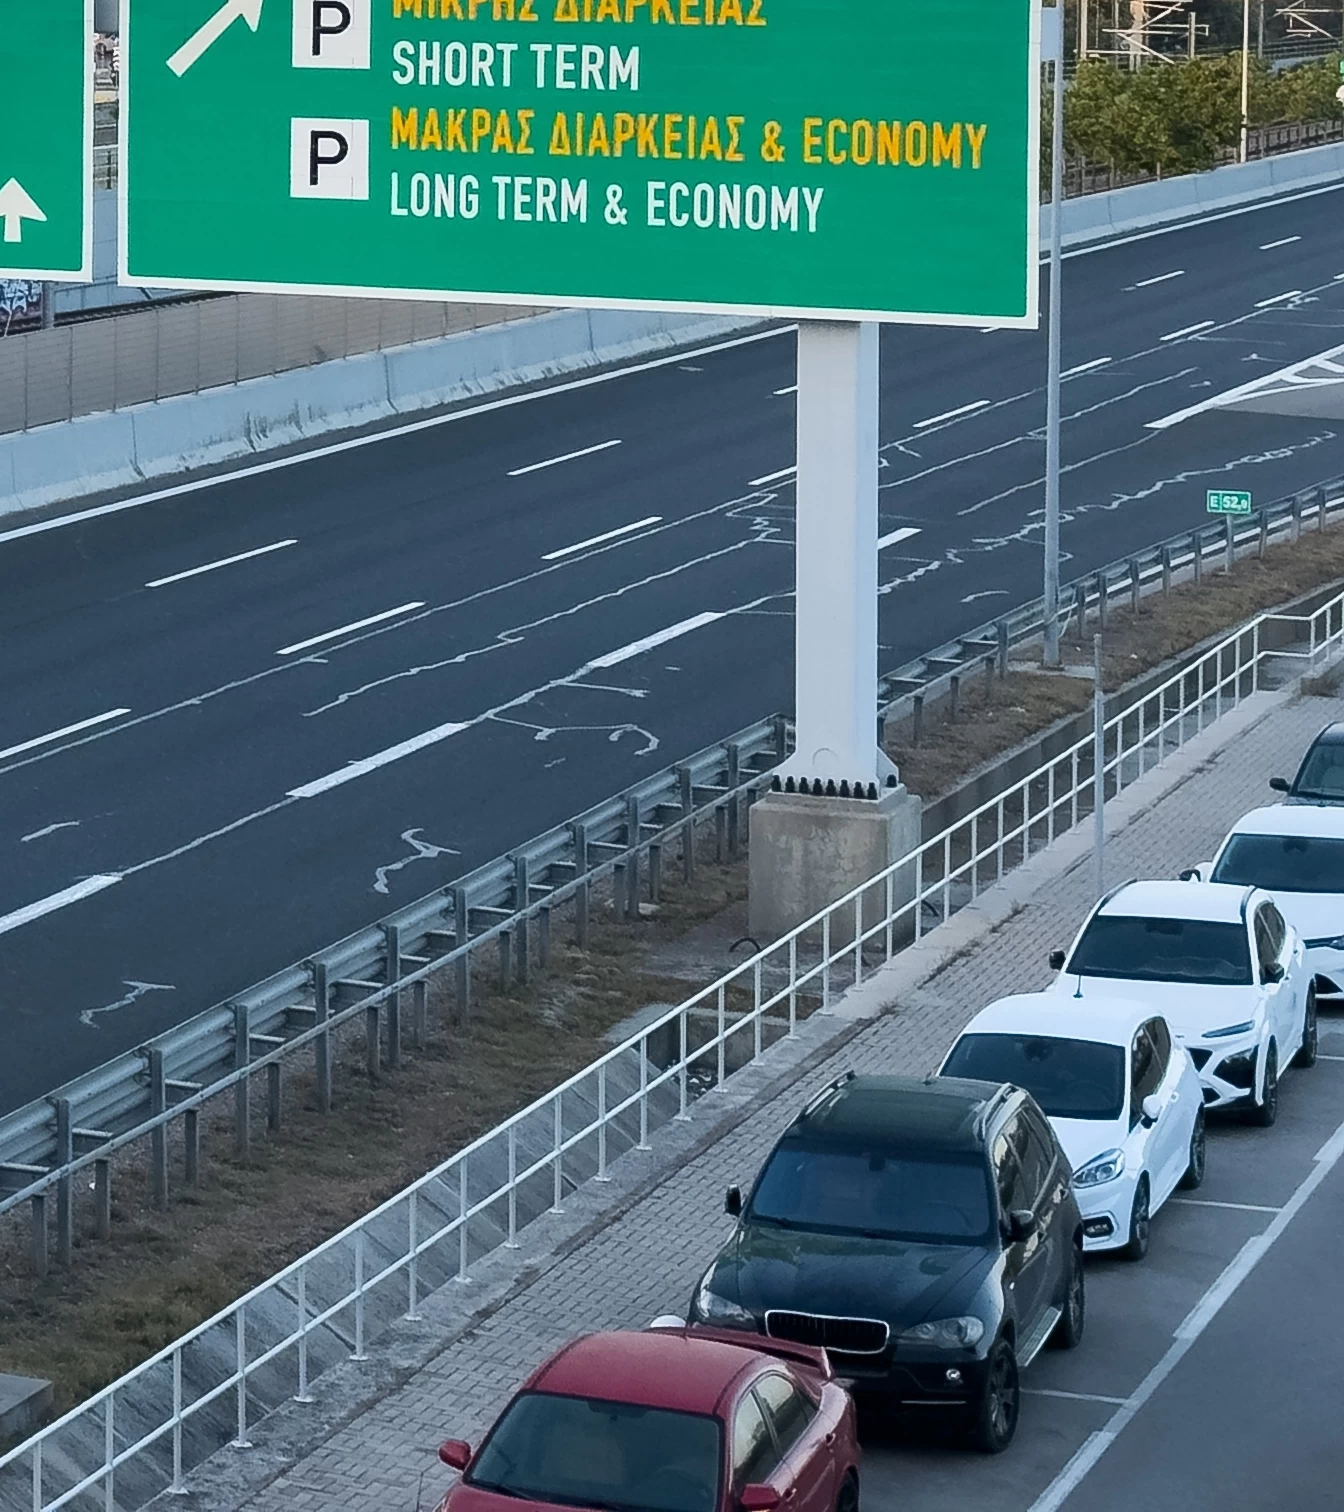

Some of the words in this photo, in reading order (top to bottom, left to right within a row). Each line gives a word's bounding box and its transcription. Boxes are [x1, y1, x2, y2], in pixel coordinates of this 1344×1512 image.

[312, 0, 351, 56] P
[392, 40, 519, 87] SHORT
[529, 43, 640, 92] TERM
[310, 130, 349, 186] P
[391, 106, 536, 156] ΜΑΚΡΑΣ
[548, 111, 746, 163] ΔΙΑΡΚΕΙΑΣ
[760, 119, 786, 163] &
[802, 117, 988, 169] ECONOMY
[390, 172, 480, 220] LONG
[491, 175, 588, 224] TERM
[604, 183, 629, 226] &
[647, 181, 825, 234] ECONOMY
[1210, 495, 1219, 508] E
